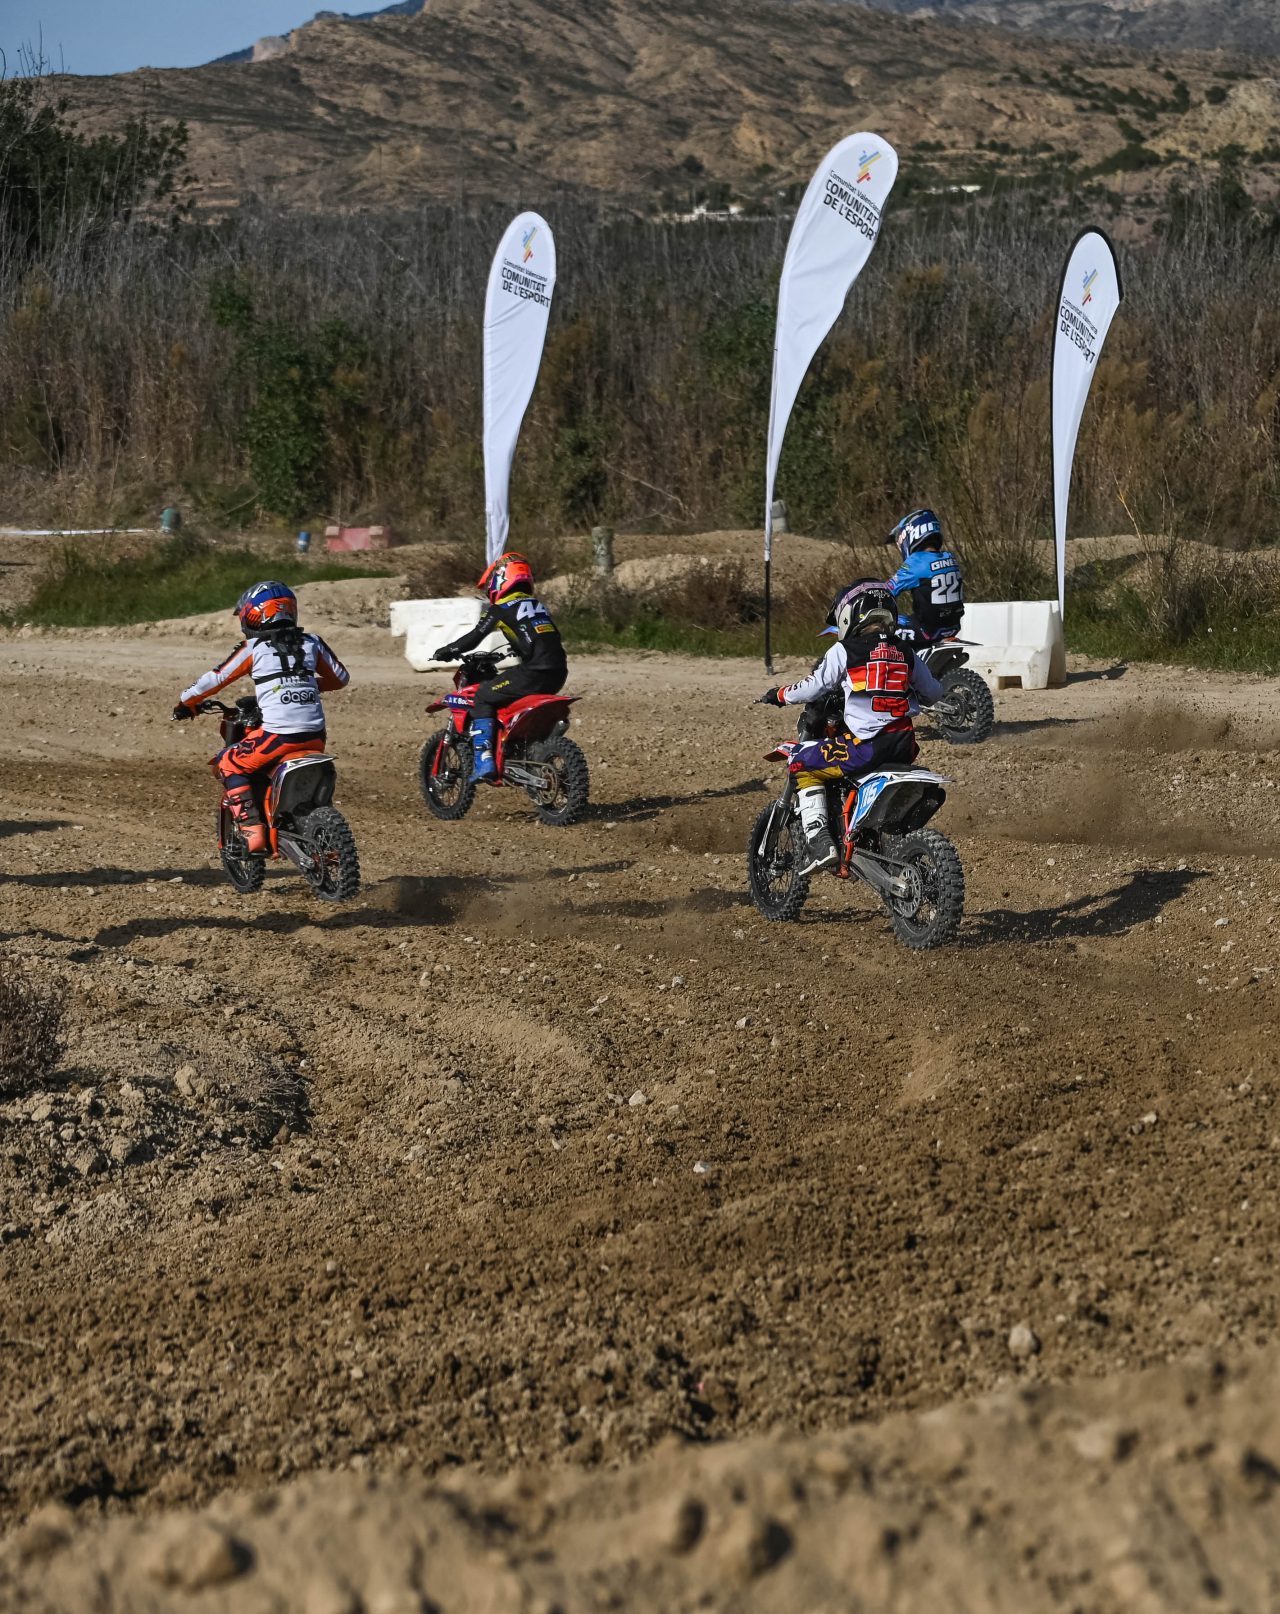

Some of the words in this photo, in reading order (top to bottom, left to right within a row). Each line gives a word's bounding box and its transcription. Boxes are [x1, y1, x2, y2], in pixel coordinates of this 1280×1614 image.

[823, 194, 839, 210] DE
[825, 179, 879, 227] COMUNITAT
[501, 267, 546, 293] COMUNITAT
[502, 280, 513, 293] DE
[514, 285, 551, 308] L'ESPORT
[1061, 320, 1071, 336] DE
